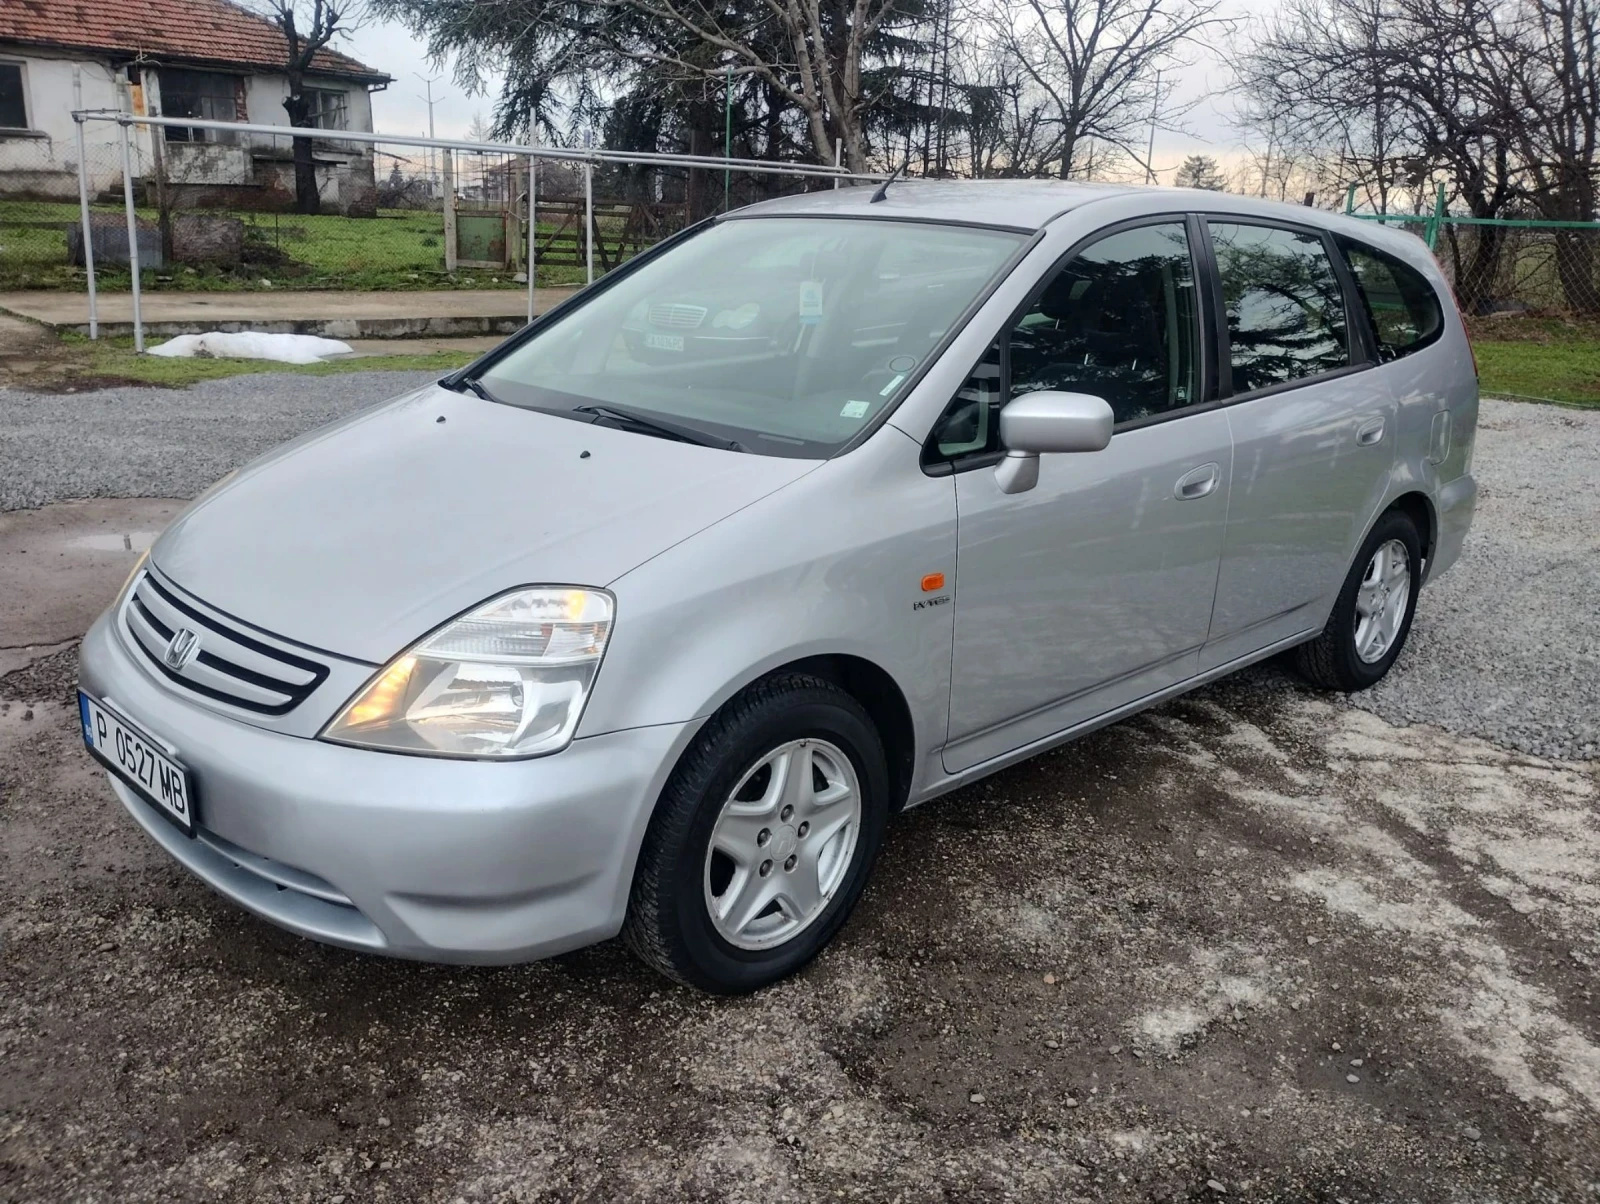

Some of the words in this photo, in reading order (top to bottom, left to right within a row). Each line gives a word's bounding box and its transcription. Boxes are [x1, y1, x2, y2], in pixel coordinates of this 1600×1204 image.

[96, 710, 107, 748] P
[115, 727, 155, 788] 0527
[158, 759, 185, 815] MB
